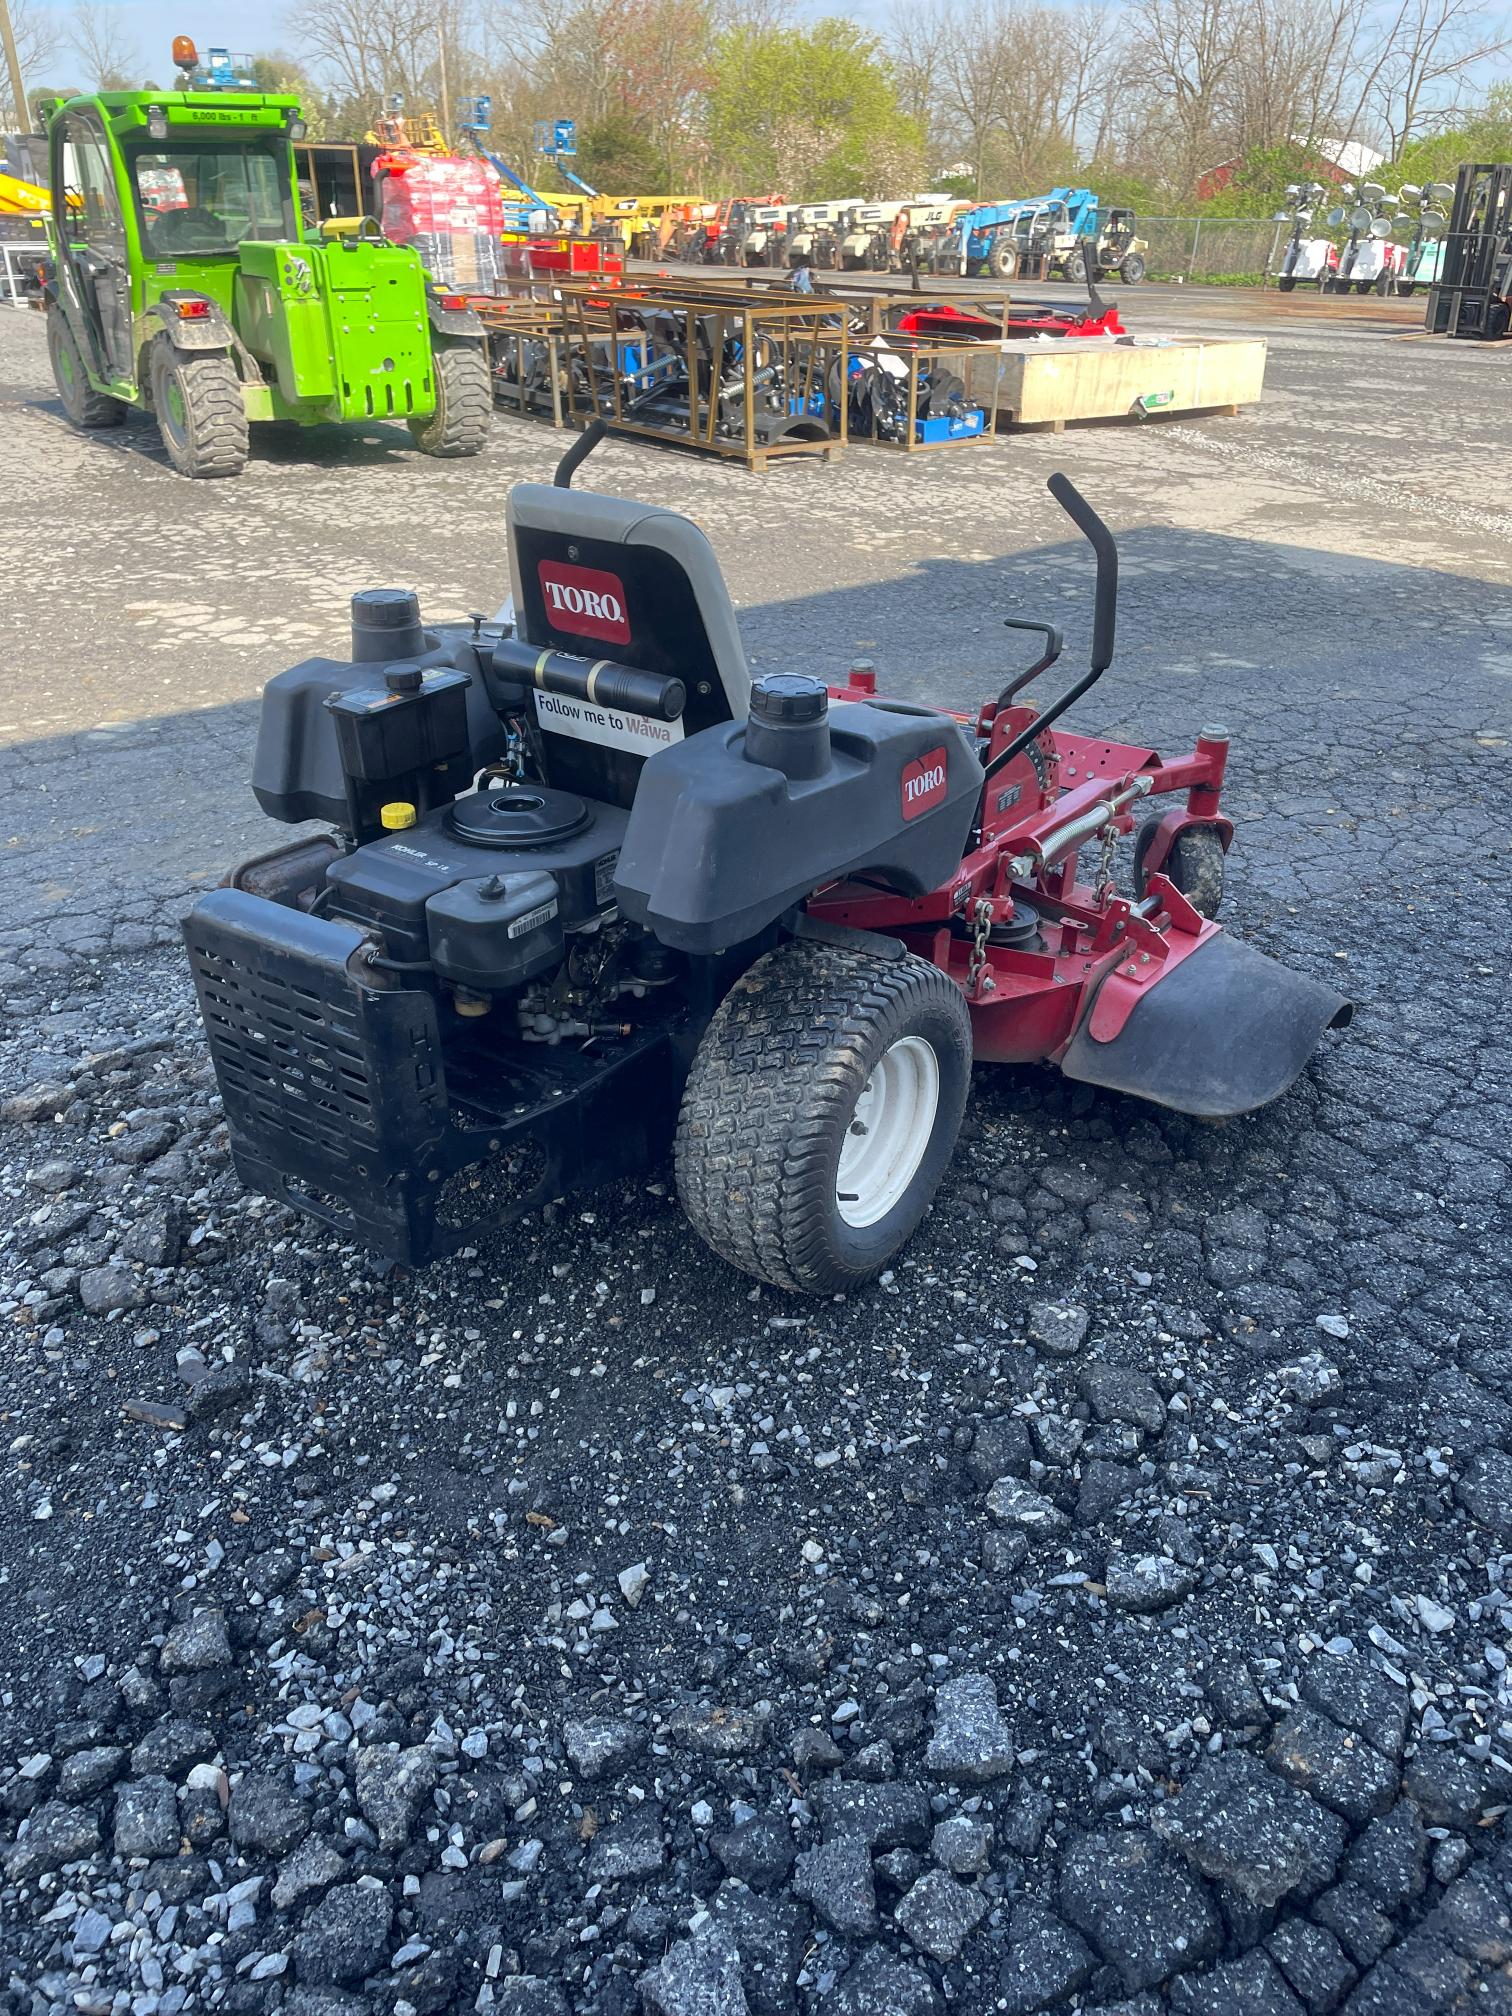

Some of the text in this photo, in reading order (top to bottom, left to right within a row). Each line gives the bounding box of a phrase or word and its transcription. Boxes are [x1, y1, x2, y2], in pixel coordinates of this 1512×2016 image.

[192, 112, 216, 120] 6,000
[925, 211, 942, 221] JLG
[545, 581, 622, 622] TORO
[538, 694, 671, 742] Follow me to Wawa
[905, 765, 943, 802] TORO
[391, 844, 428, 858] KOHLER
